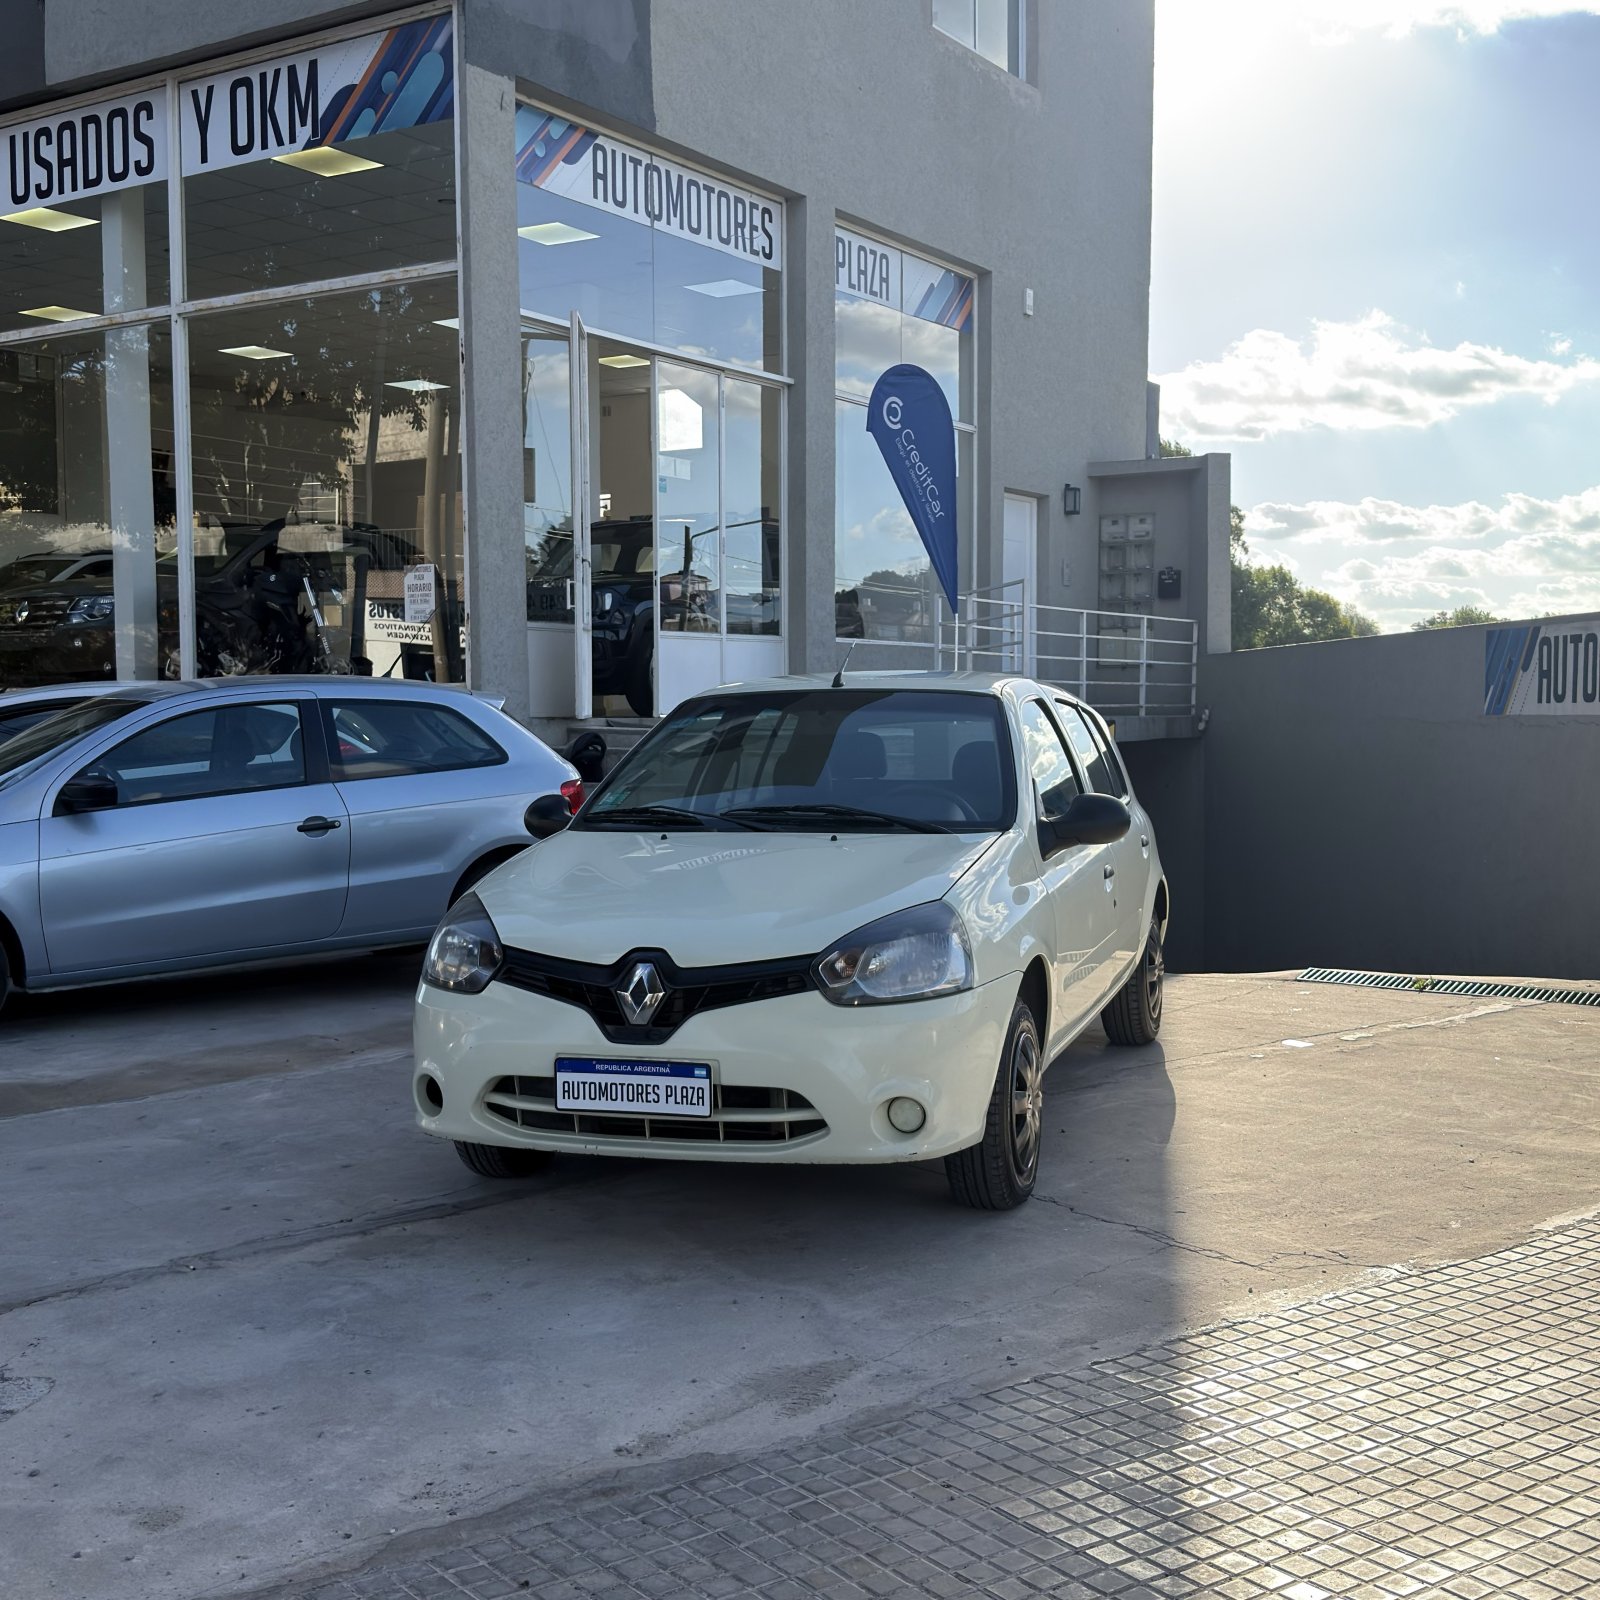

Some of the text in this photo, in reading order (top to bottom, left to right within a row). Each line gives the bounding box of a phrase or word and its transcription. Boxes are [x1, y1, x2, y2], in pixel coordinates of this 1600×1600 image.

[9, 100, 155, 205] USADOS
[190, 85, 214, 164] Y
[592, 143, 890, 301] AUTOMOTORES PLAZA
[901, 428, 945, 518] CreditCar
[407, 583, 432, 592] HORARIO
[1537, 632, 1600, 704] AUTO
[562, 1080, 705, 1107] AUTOMOTORES PLAZA
[595, 1064, 671, 1073] REPUBLICA ARGENTINA
